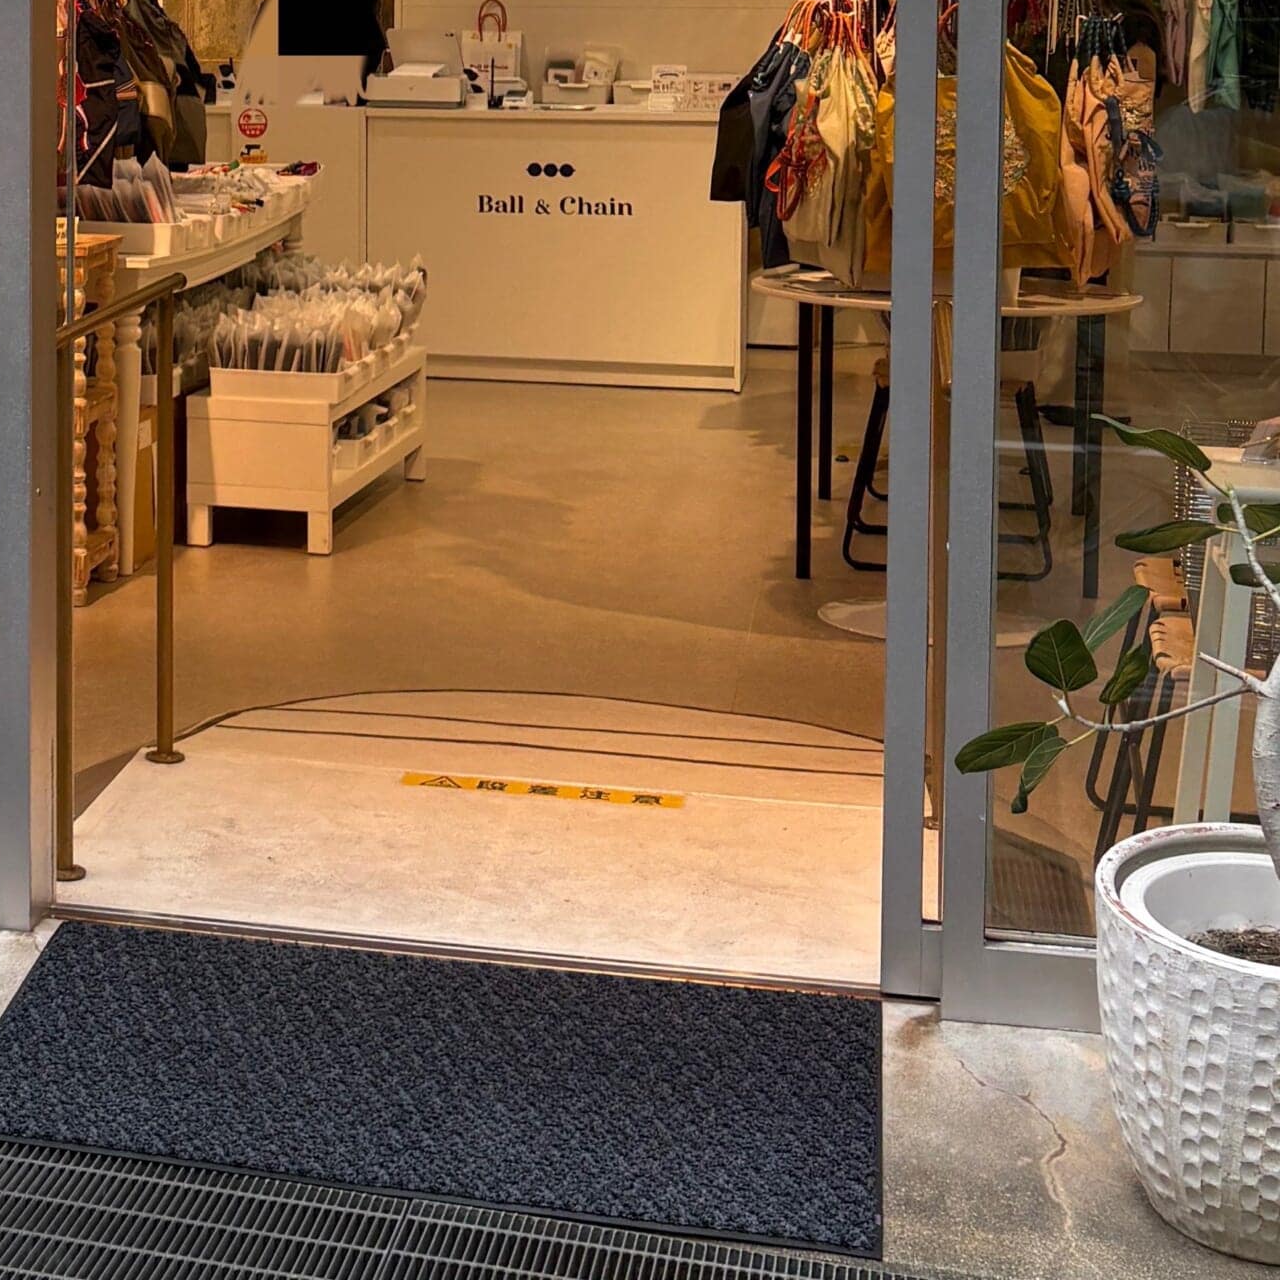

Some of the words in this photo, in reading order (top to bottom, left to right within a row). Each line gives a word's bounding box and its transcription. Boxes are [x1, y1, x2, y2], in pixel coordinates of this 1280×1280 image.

[478, 195, 524, 214] Ball
[535, 199, 551, 215] &
[560, 196, 633, 216] Chain
